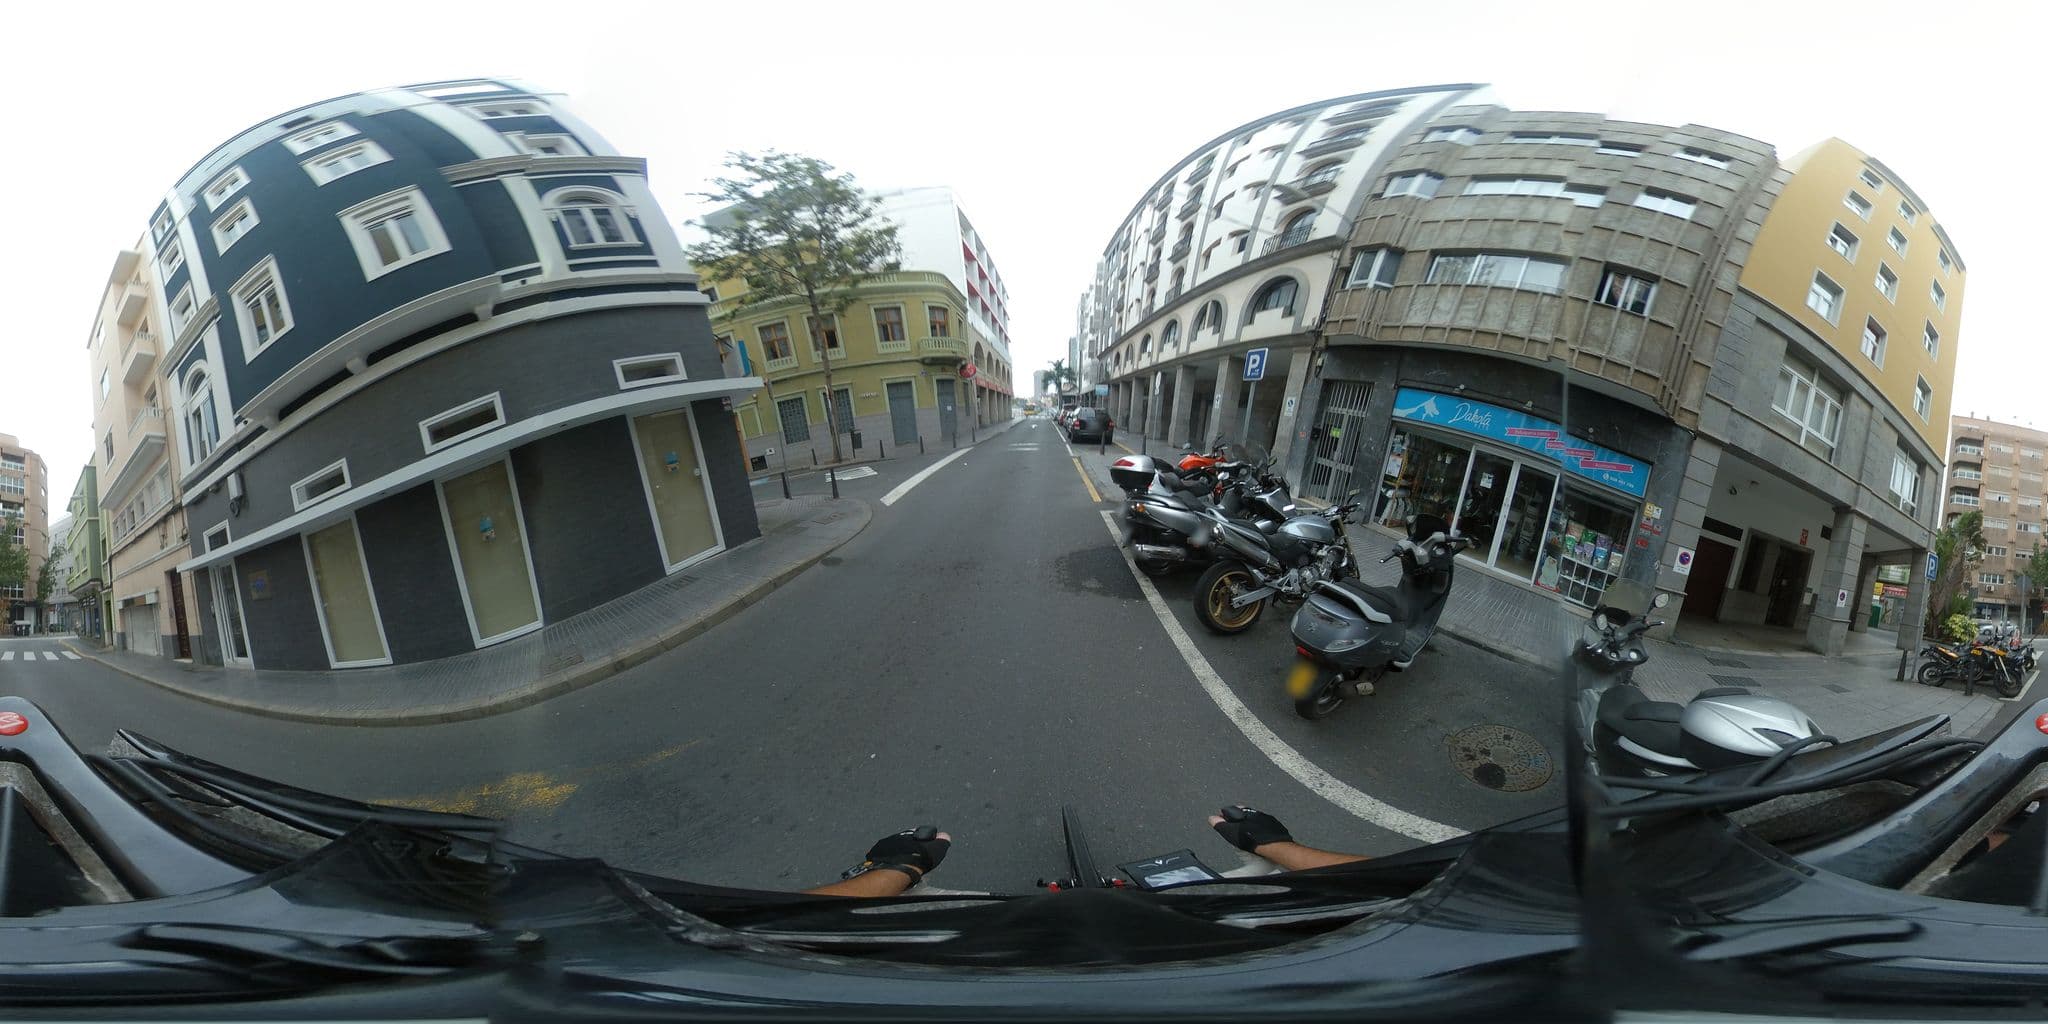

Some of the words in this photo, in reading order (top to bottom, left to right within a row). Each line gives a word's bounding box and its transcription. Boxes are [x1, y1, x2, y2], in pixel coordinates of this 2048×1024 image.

[1247, 354, 1260, 376] P
[1448, 402, 1492, 426] Dakota
[1928, 558, 1935, 575] P
